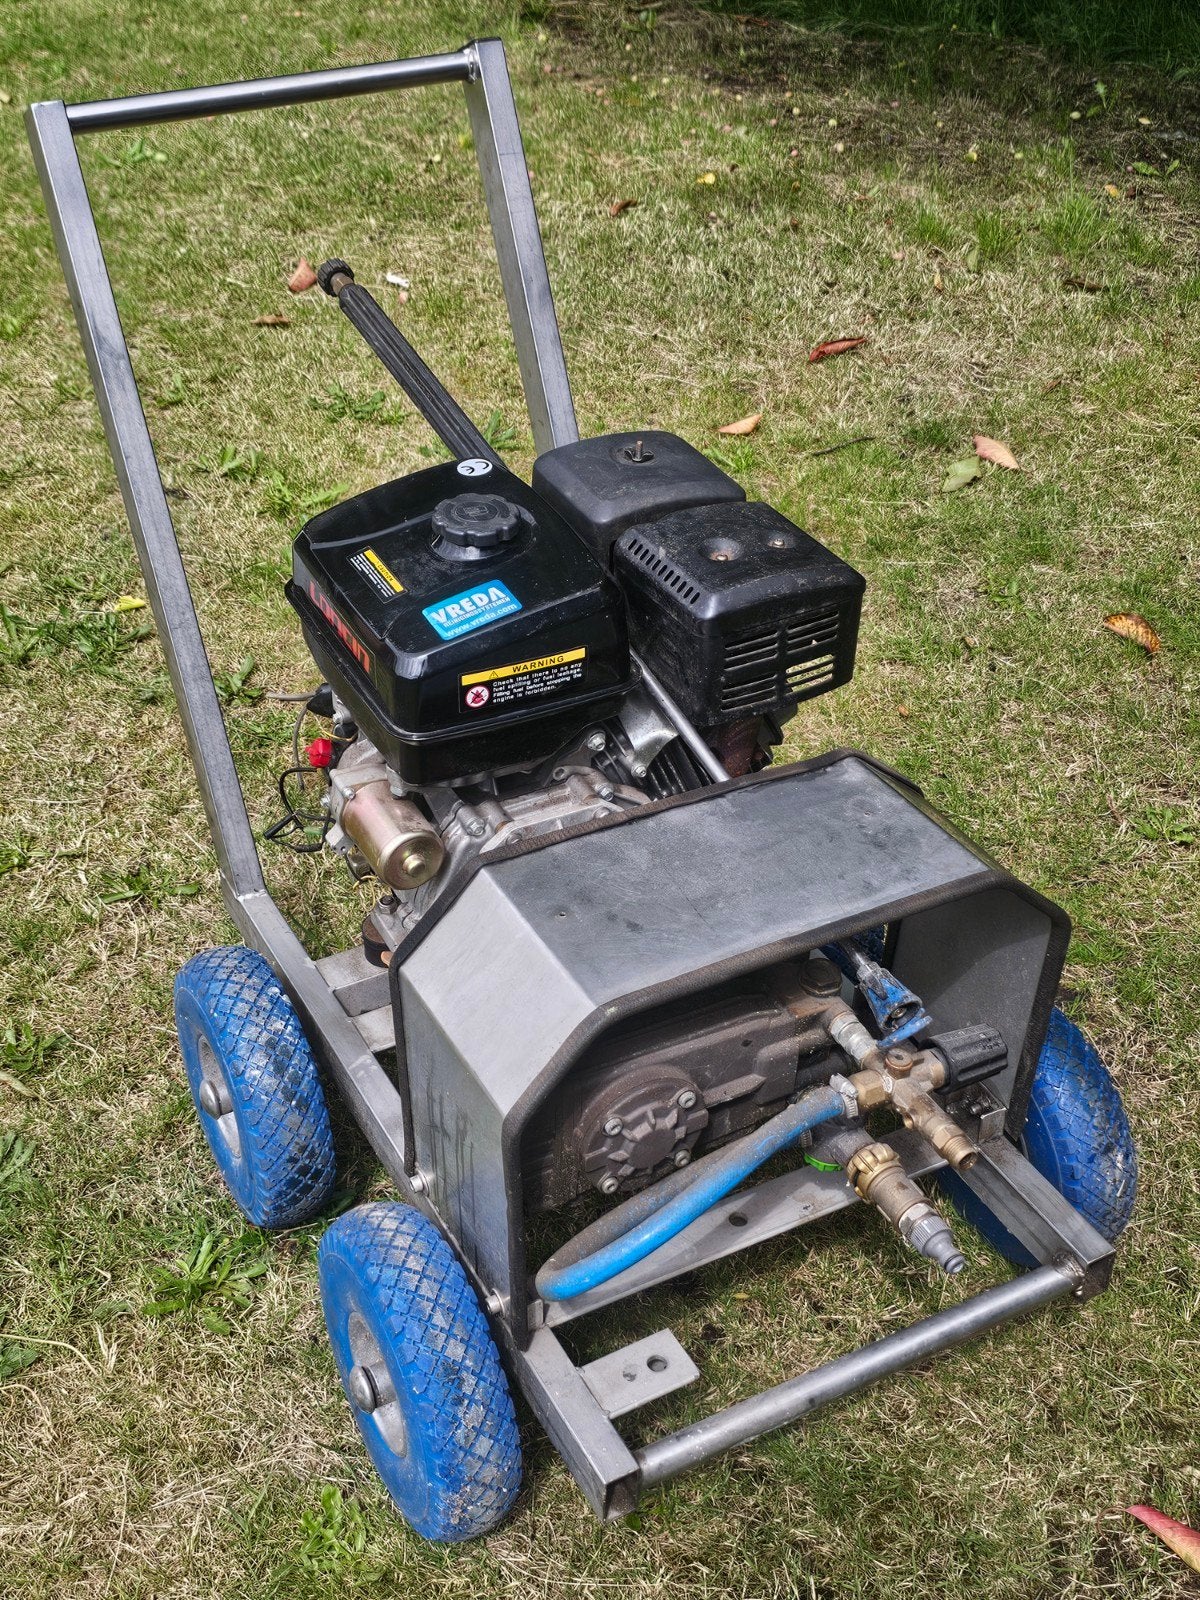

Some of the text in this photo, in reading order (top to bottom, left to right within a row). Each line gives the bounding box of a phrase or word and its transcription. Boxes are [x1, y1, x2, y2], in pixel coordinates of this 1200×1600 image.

[430, 587, 507, 624] VREDA
[446, 604, 517, 637] www.vreda.com
[492, 678, 514, 687] Check
[532, 671, 549, 679] there
[570, 662, 582, 670] any
[512, 656, 564, 673] WARNING
[493, 685, 505, 693] fuel
[557, 668, 582, 678] leakage.
[526, 682, 544, 690] before
[492, 694, 514, 703] engine
[525, 685, 557, 696] forbidden.
